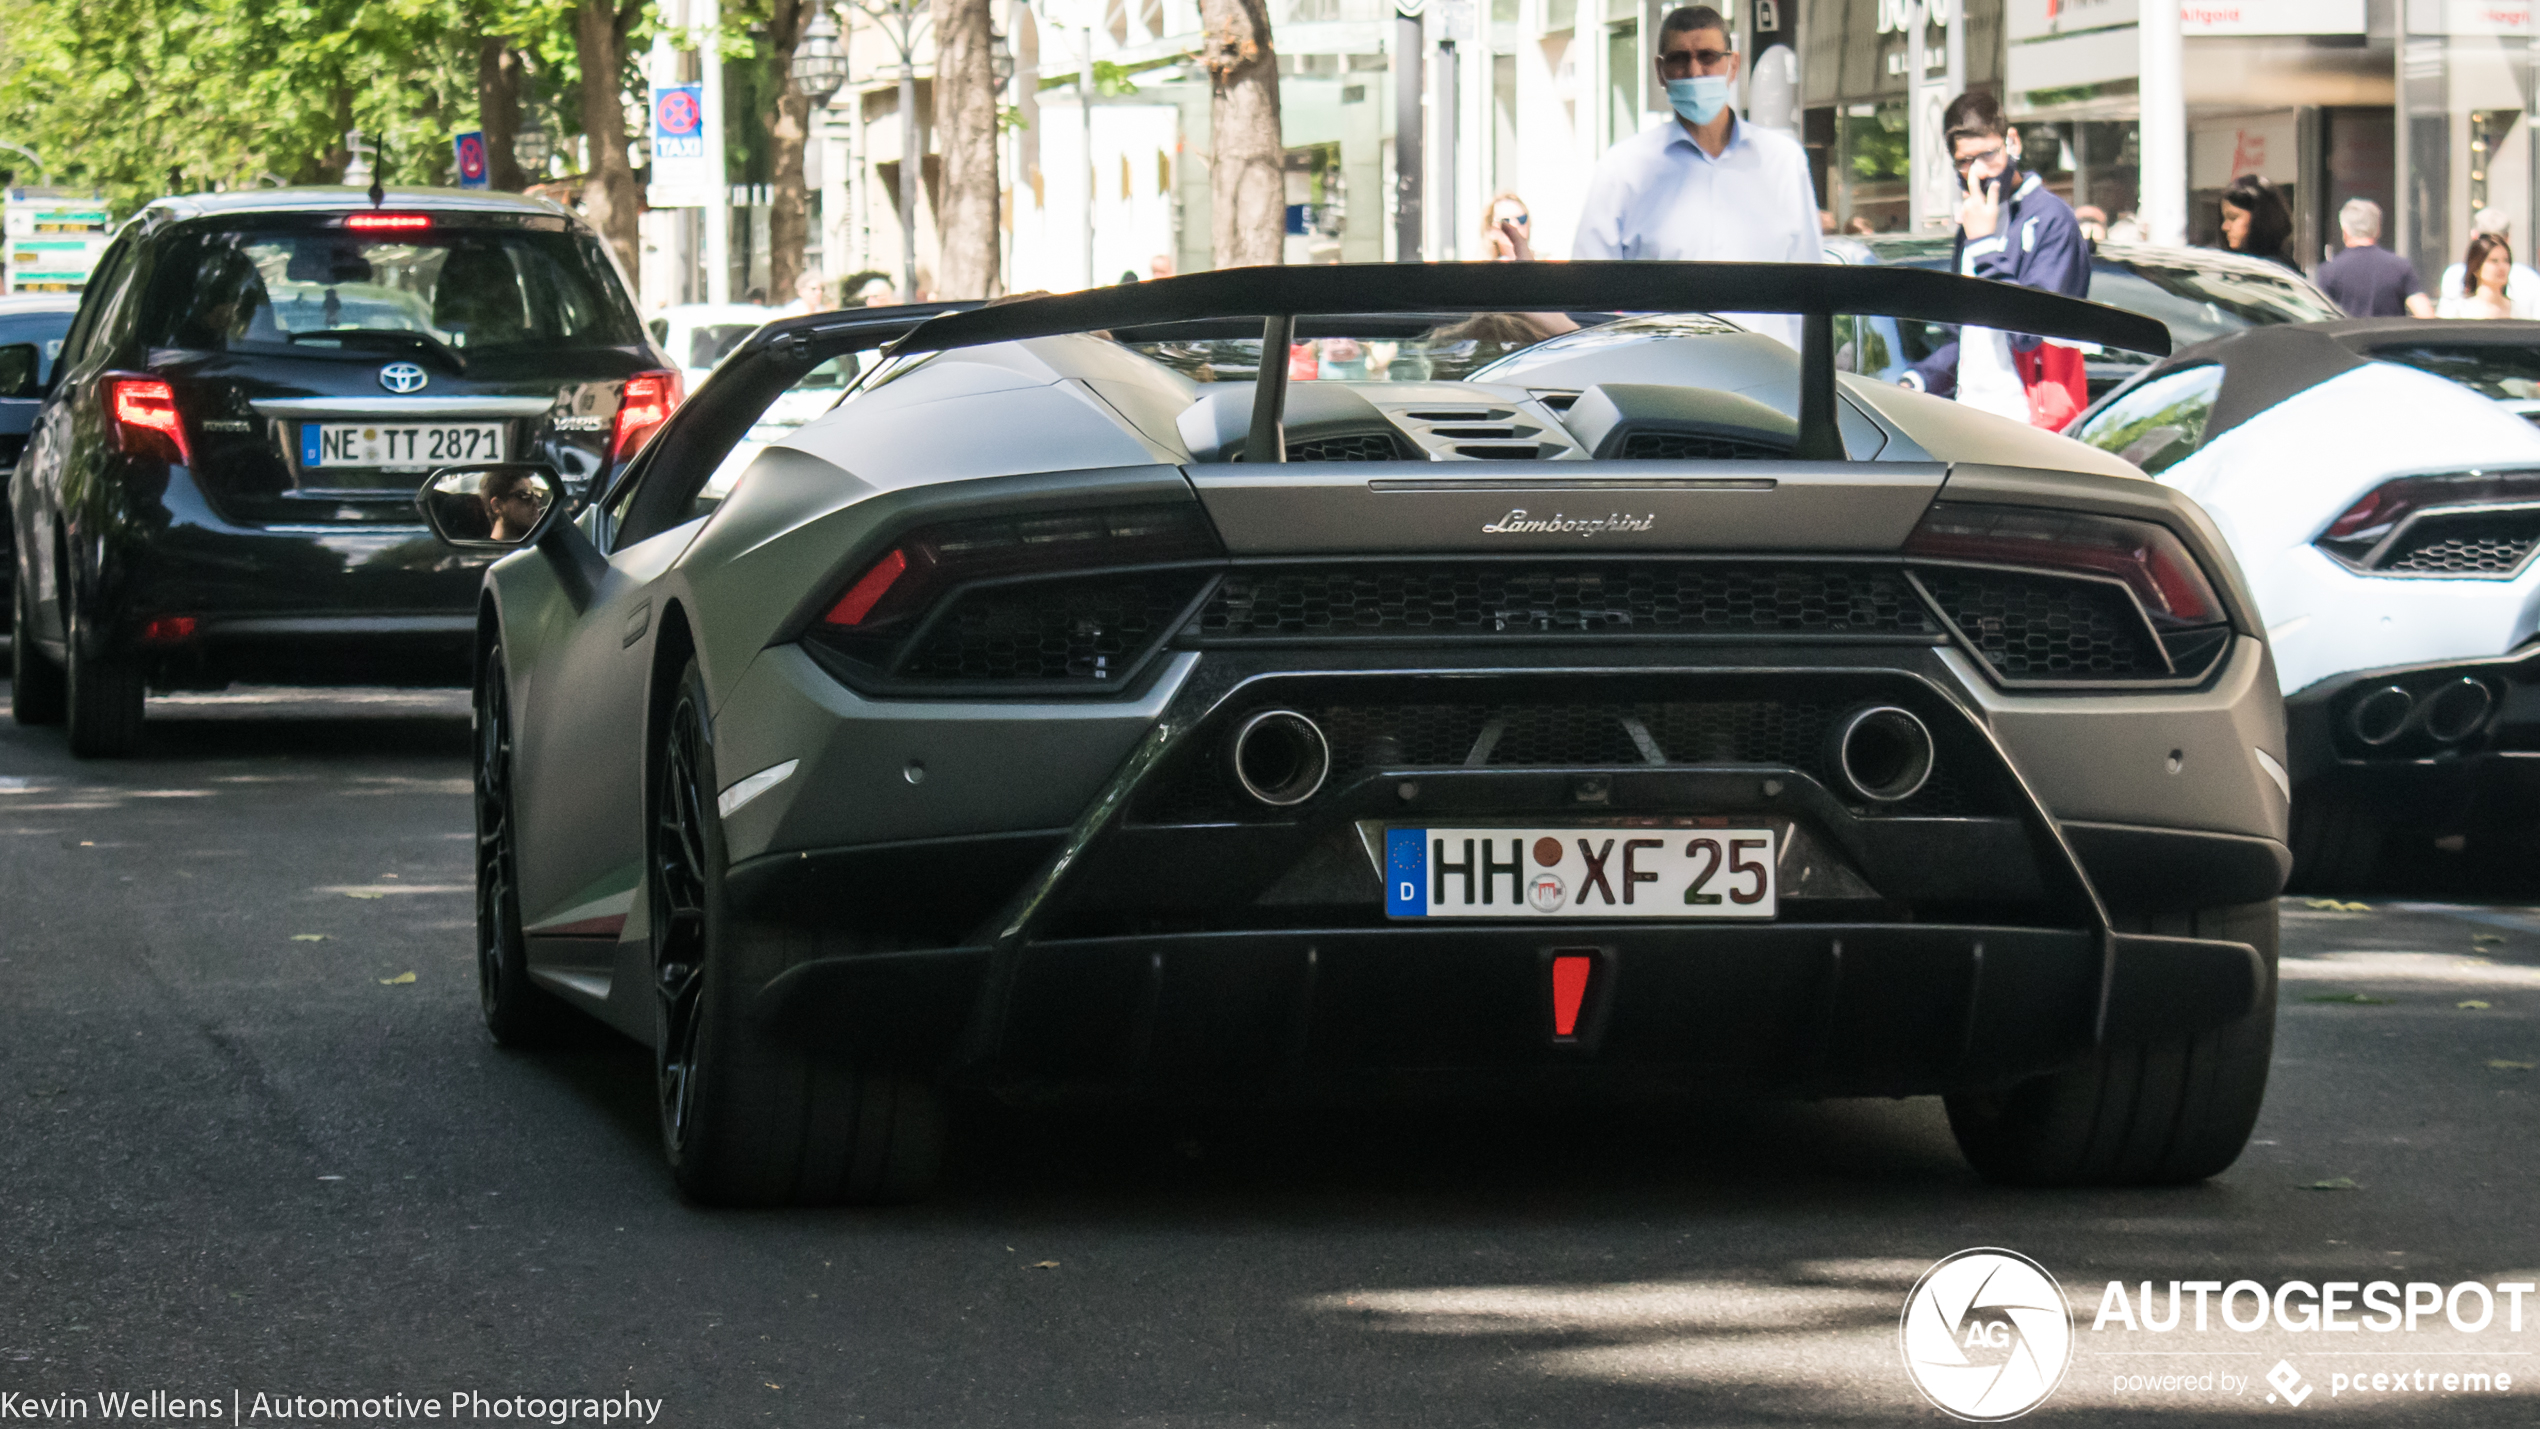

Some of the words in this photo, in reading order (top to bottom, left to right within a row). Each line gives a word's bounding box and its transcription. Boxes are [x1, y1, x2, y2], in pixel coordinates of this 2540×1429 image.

[657, 137, 702, 156] TAXI
[323, 429, 358, 460] NE
[384, 429, 419, 460] TT
[429, 429, 499, 460] 2871
[1482, 509, 1655, 537] Lamborghini
[1400, 881, 1415, 901] D
[1433, 838, 1524, 905] HH
[1575, 838, 1664, 905] XF
[1684, 838, 1768, 905] 25
